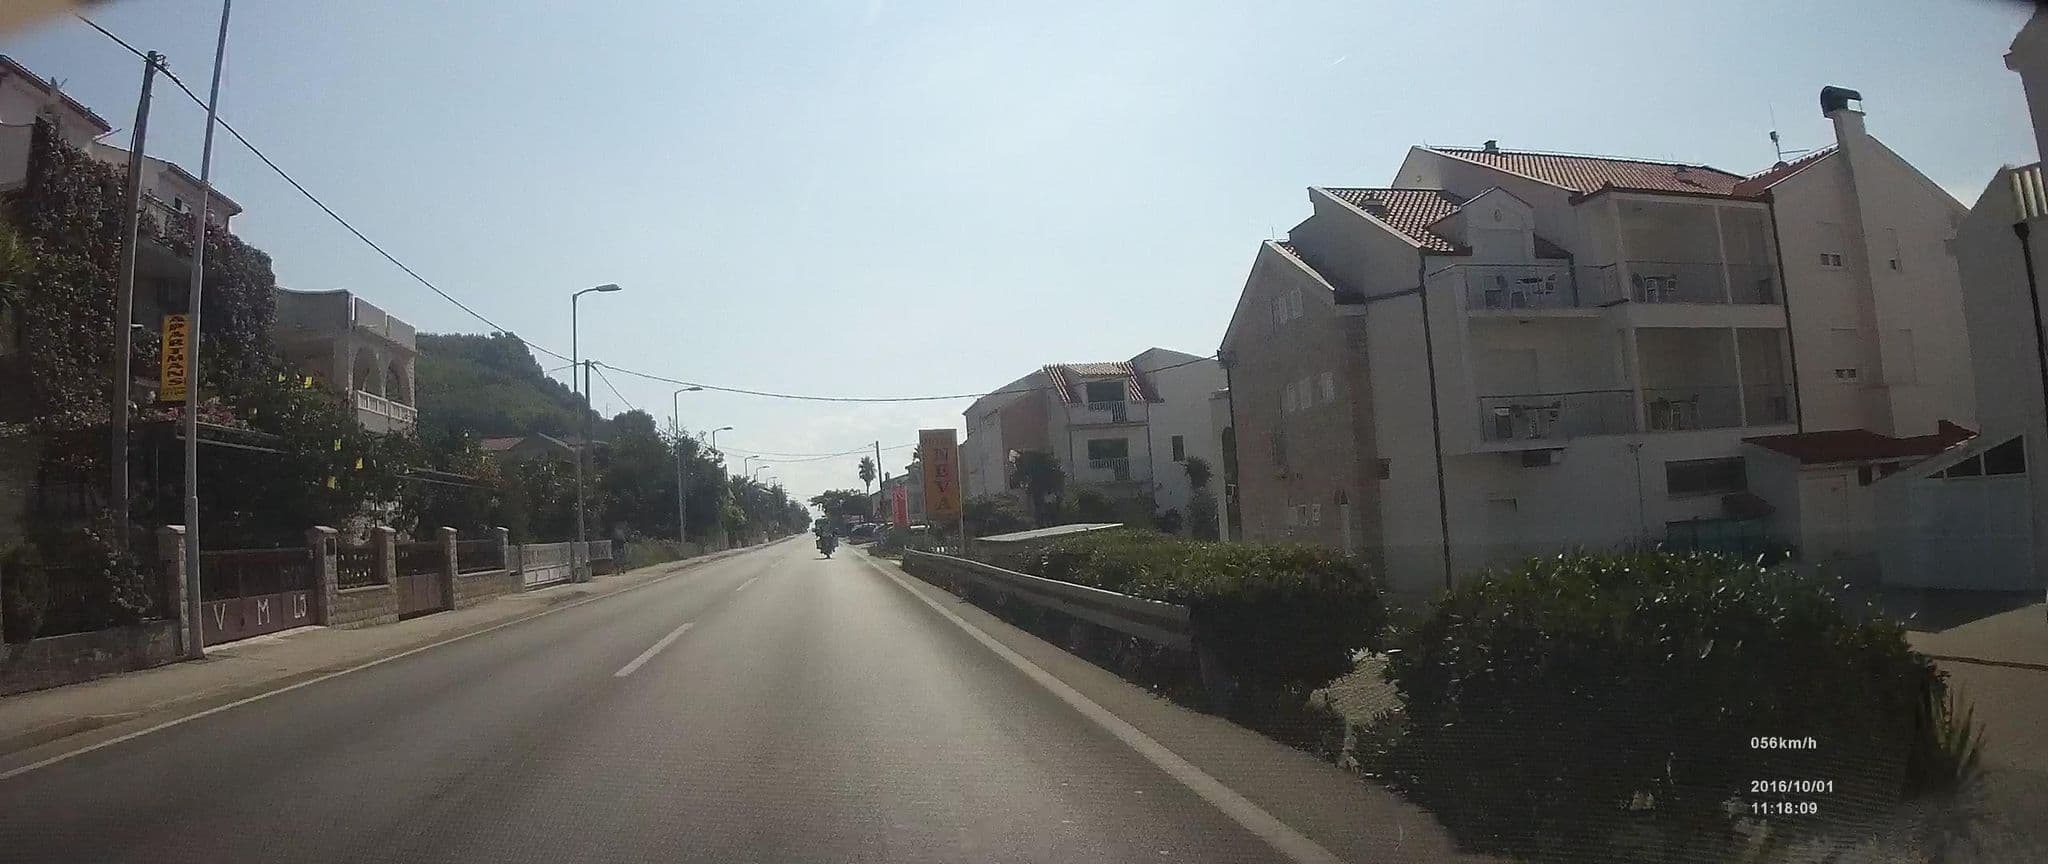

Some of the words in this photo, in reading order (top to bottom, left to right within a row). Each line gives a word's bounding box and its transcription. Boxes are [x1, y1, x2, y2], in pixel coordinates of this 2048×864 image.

[935, 447, 951, 511] NEVA
[213, 603, 226, 630] V
[257, 598, 270, 625] M
